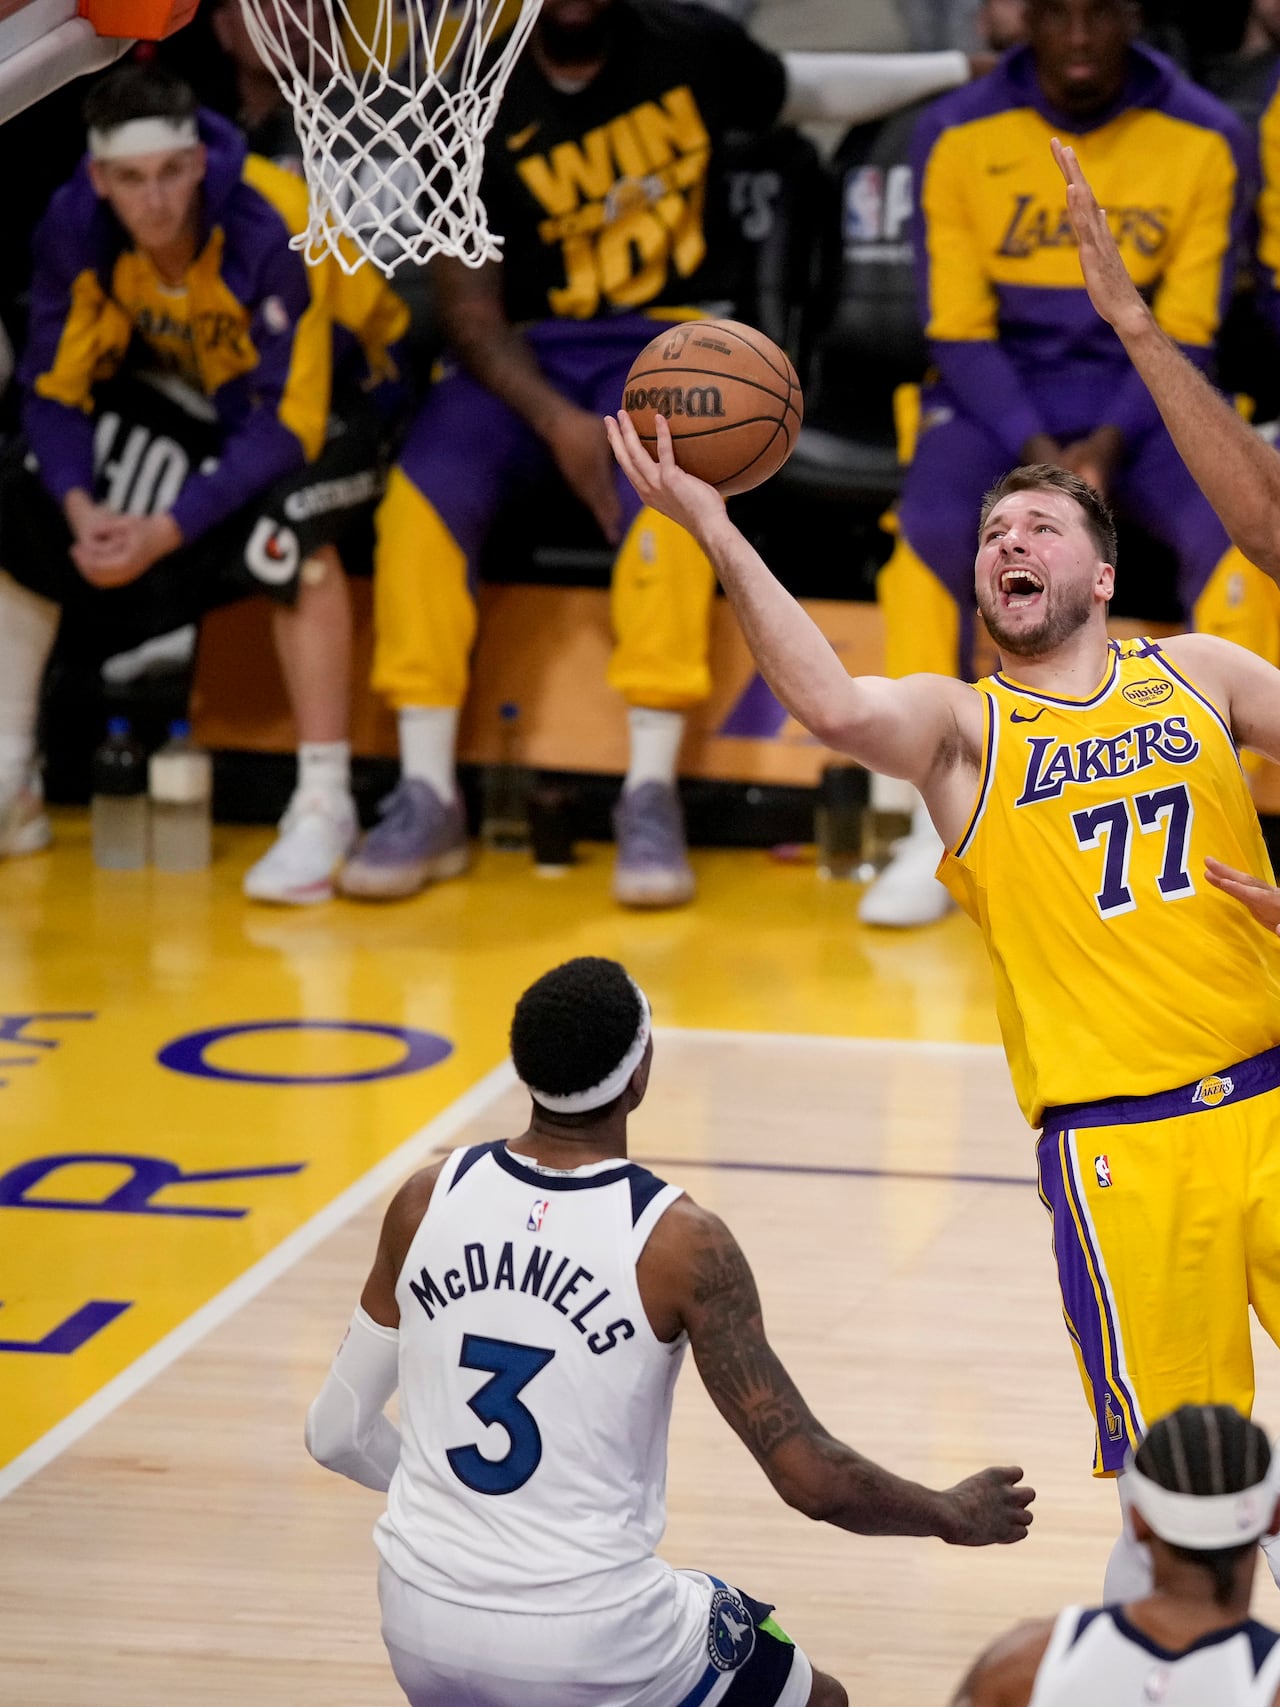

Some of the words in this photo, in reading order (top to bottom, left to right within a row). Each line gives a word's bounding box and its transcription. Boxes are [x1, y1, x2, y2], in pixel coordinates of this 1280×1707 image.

[515, 84, 712, 217] WIN
[998, 195, 1173, 258] LAKRS
[624, 386, 726, 419] Wilson
[1125, 683, 1170, 701] bibigo
[1014, 716, 1200, 808] LAKERS
[1069, 781, 1196, 920] 77
[1193, 1082, 1234, 1103] LAKERS
[409, 1241, 635, 1355] McDANIELS
[446, 1333, 556, 1496] 3
